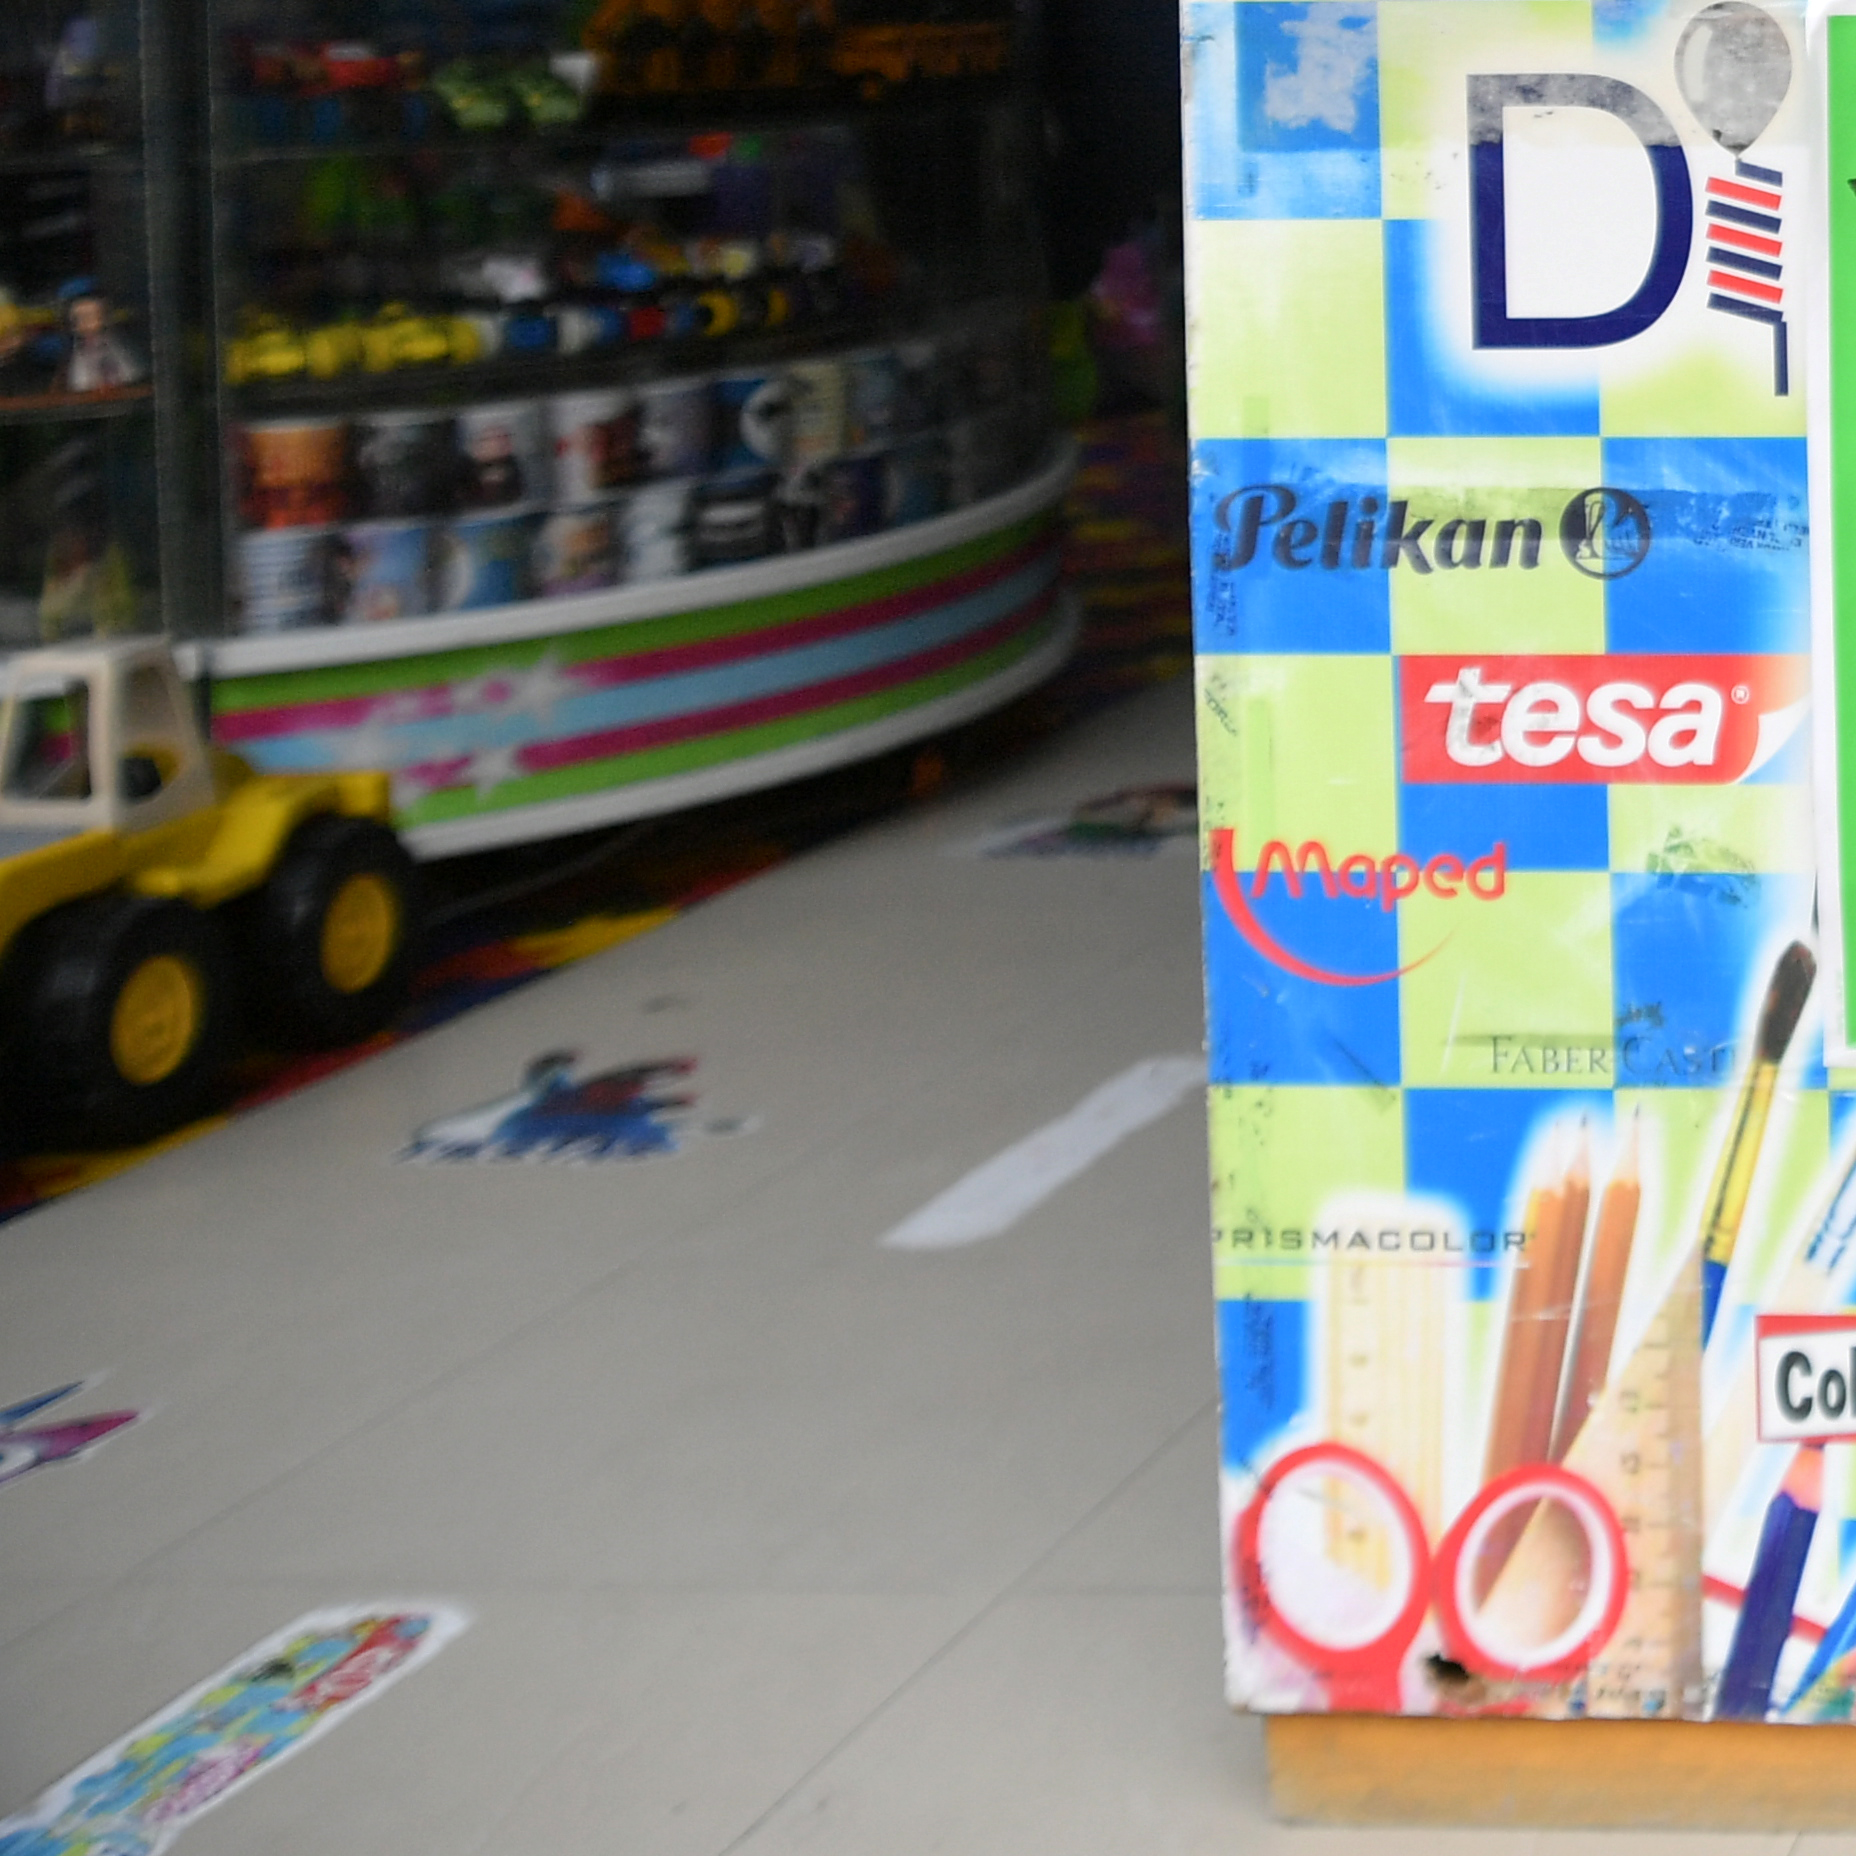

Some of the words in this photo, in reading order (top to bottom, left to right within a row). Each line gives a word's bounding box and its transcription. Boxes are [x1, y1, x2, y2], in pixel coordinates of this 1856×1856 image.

[1212, 484, 1543, 574] Pelikan
[1424, 667, 1723, 768] tesa
[1250, 840, 1510, 912] Maped
